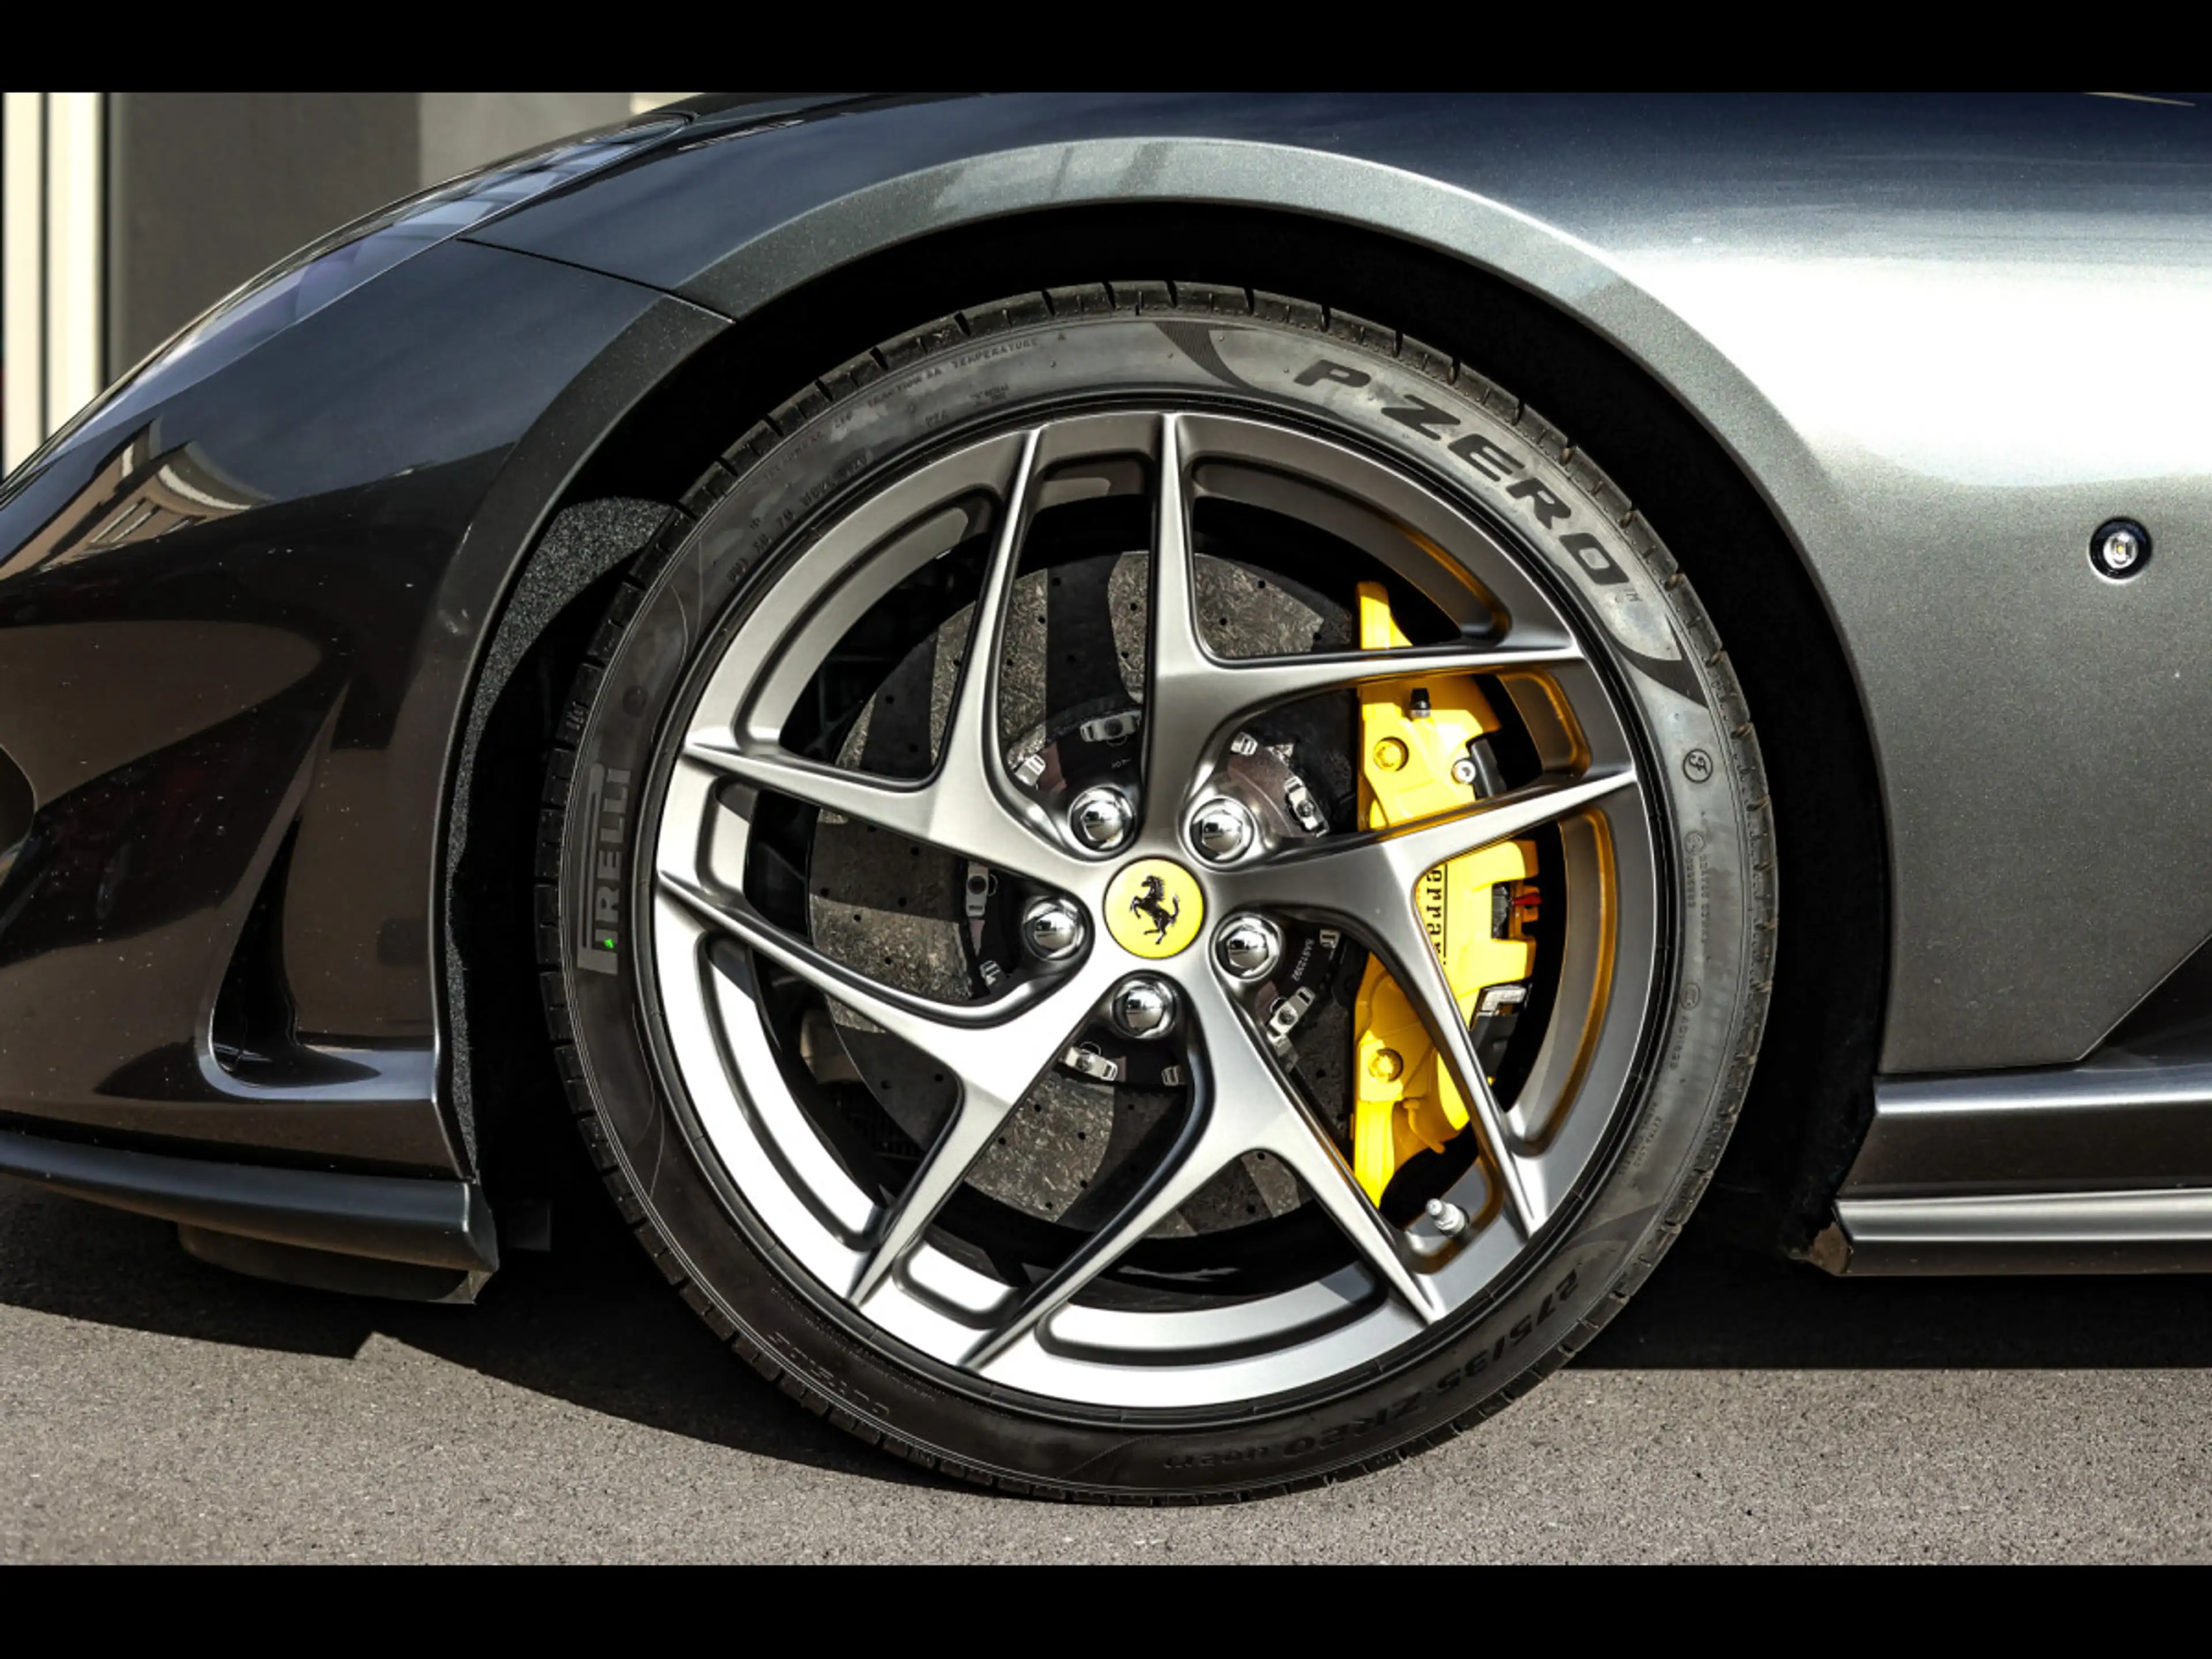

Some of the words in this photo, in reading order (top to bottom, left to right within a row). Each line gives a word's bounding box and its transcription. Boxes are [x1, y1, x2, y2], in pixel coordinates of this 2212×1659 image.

[1294, 357, 1371, 388] P
[1381, 394, 1629, 585] ZERO
[577, 763, 631, 975] PIRELLI
[1437, 1268, 1580, 1393] 275/35
